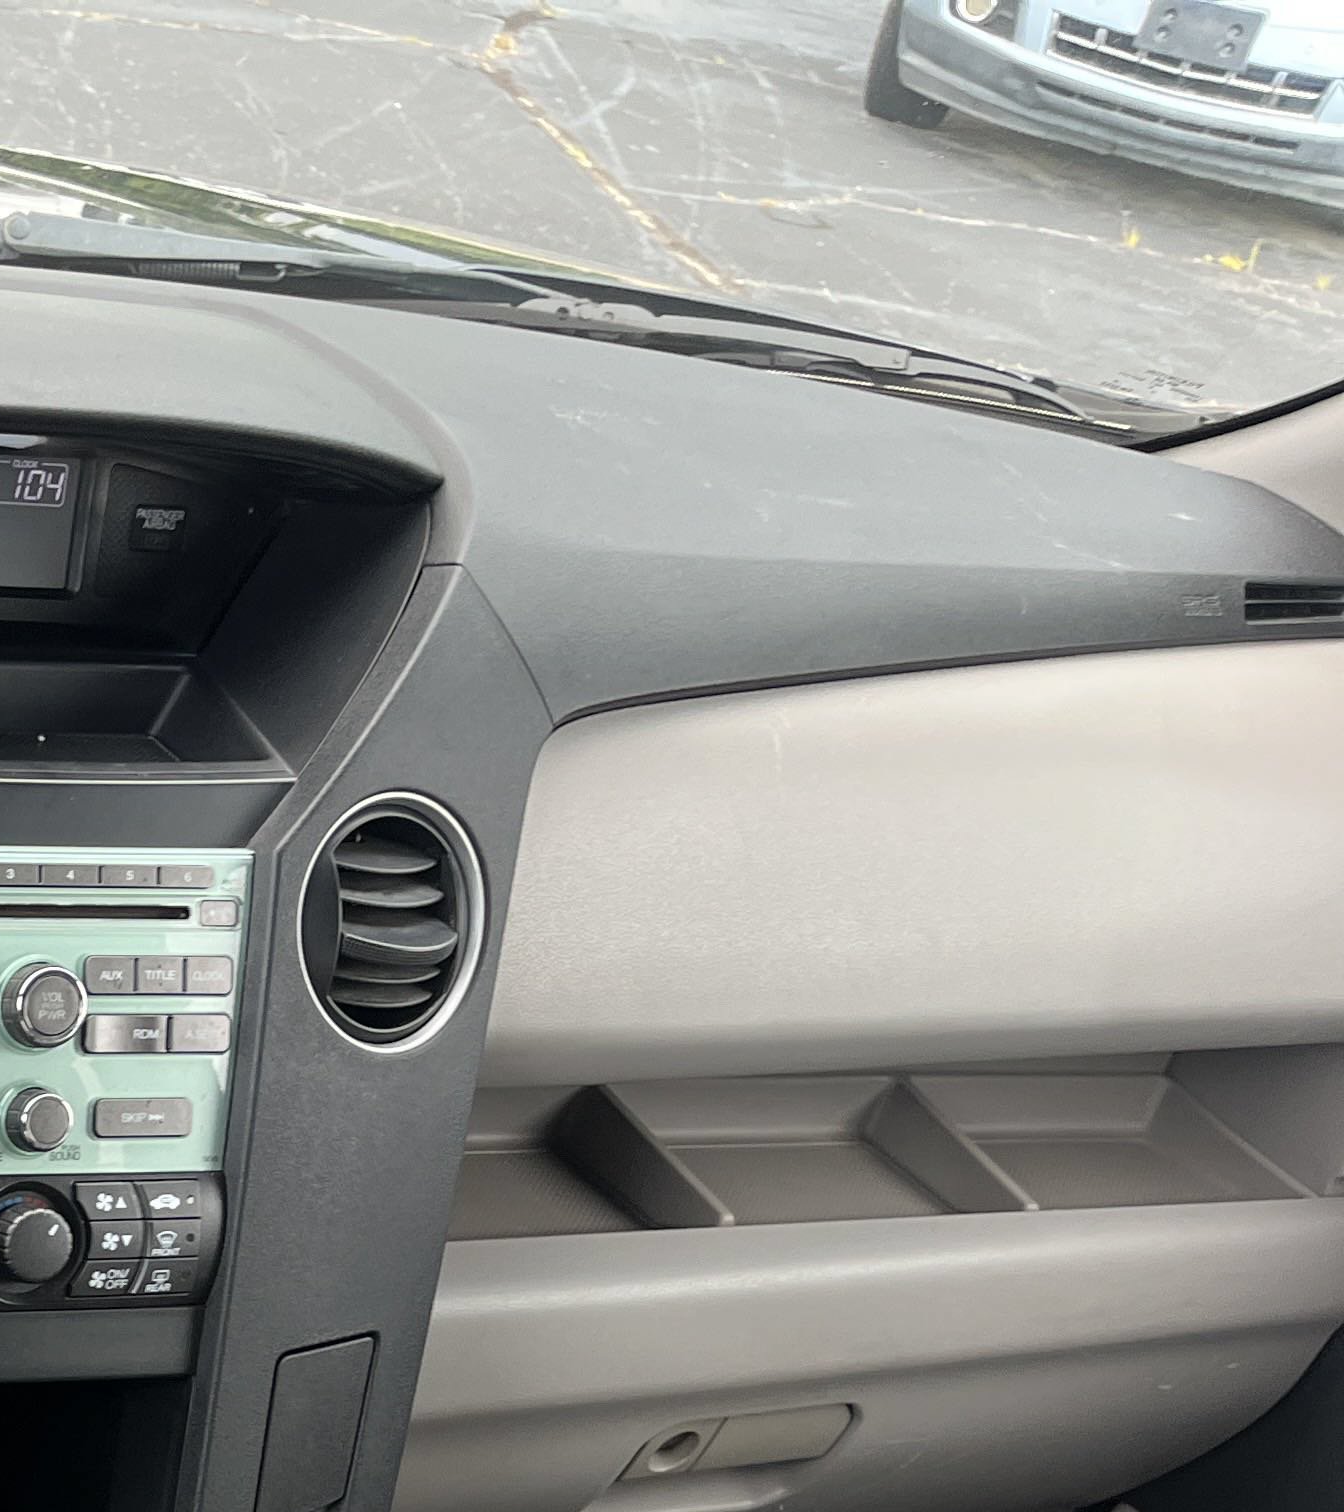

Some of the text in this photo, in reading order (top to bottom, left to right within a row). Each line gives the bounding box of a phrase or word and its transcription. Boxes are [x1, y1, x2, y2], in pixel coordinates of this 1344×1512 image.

[14, 470, 65, 501] 104
[6, 869, 15, 880] 3
[66, 870, 75, 880] 4
[126, 870, 134, 881] 5
[99, 970, 123, 980] AUX
[144, 970, 177, 980] TITLE
[133, 1029, 160, 1040] RDM
[122, 1112, 147, 1123] SKIP
[104, 1279, 129, 1290] OFF
[145, 1283, 172, 1293] REAR
